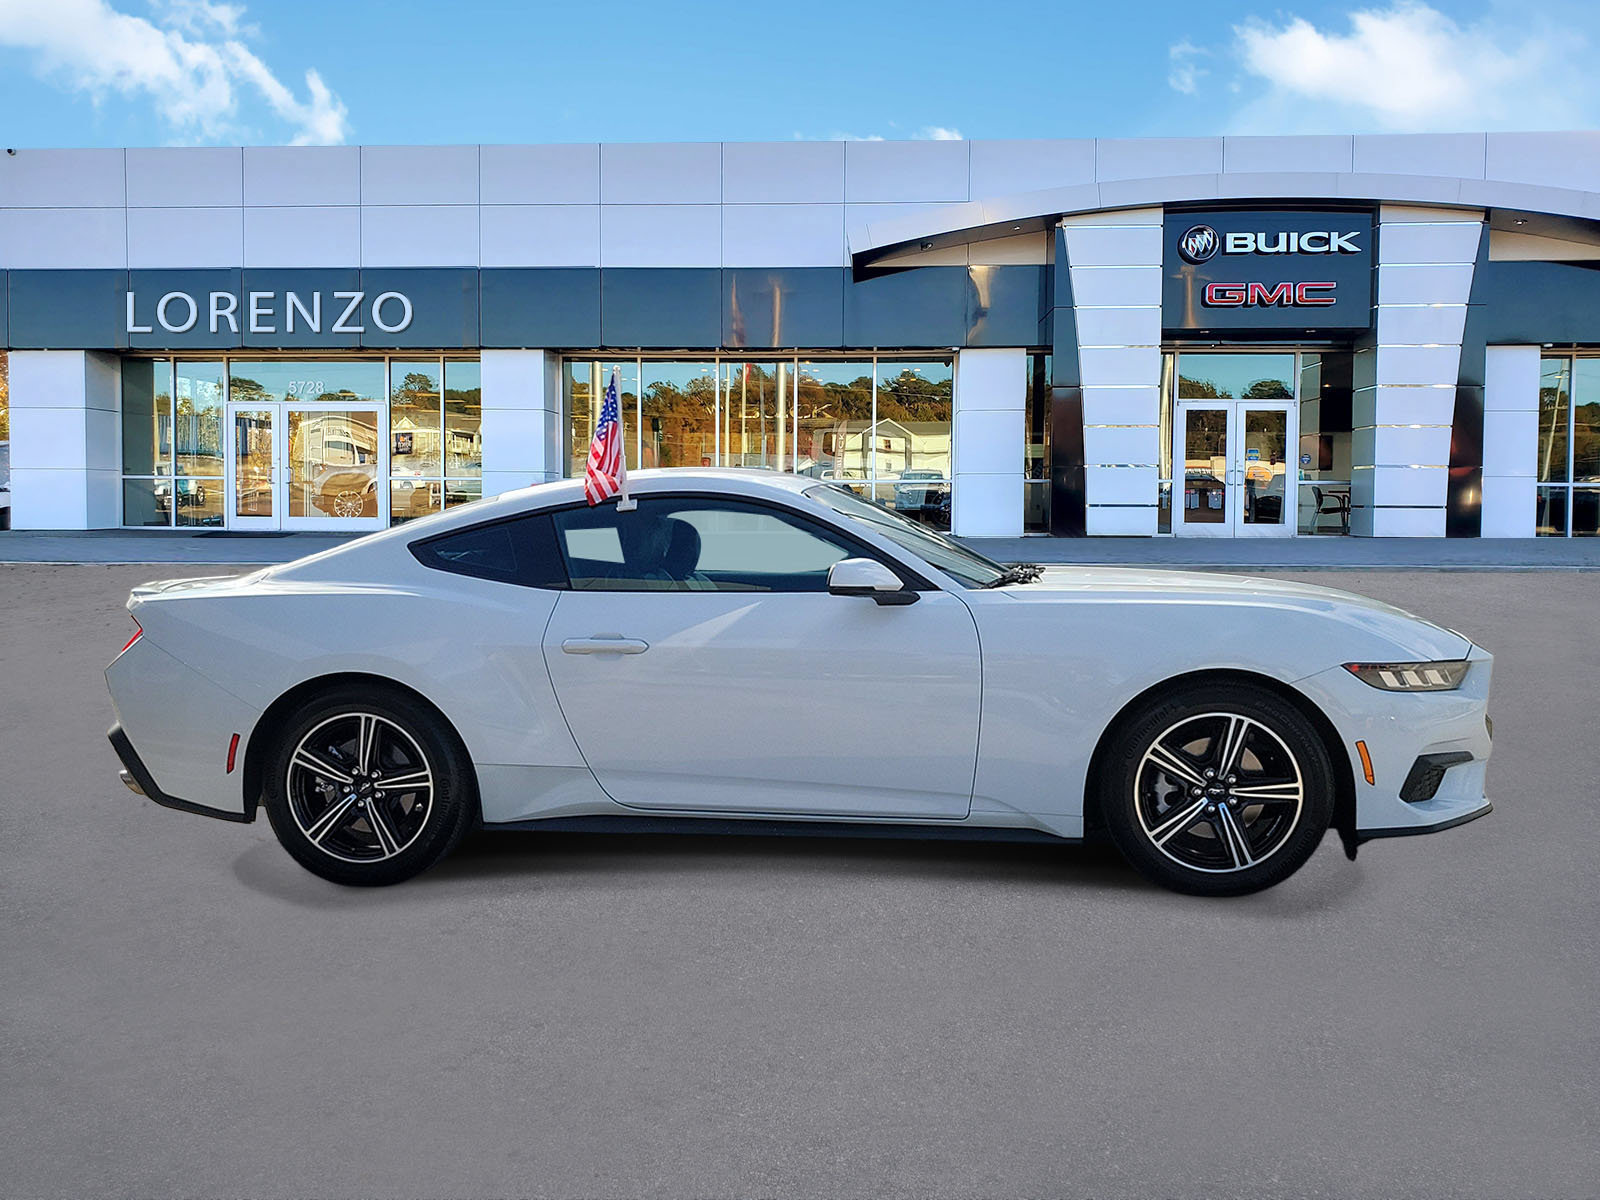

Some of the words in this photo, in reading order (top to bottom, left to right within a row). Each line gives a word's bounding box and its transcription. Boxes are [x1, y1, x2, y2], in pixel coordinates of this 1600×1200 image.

[1226, 231, 1361, 253] BUICK
[1204, 281, 1337, 306] GMC
[126, 291, 414, 334] LORENZO
[288, 381, 325, 394] 5728
